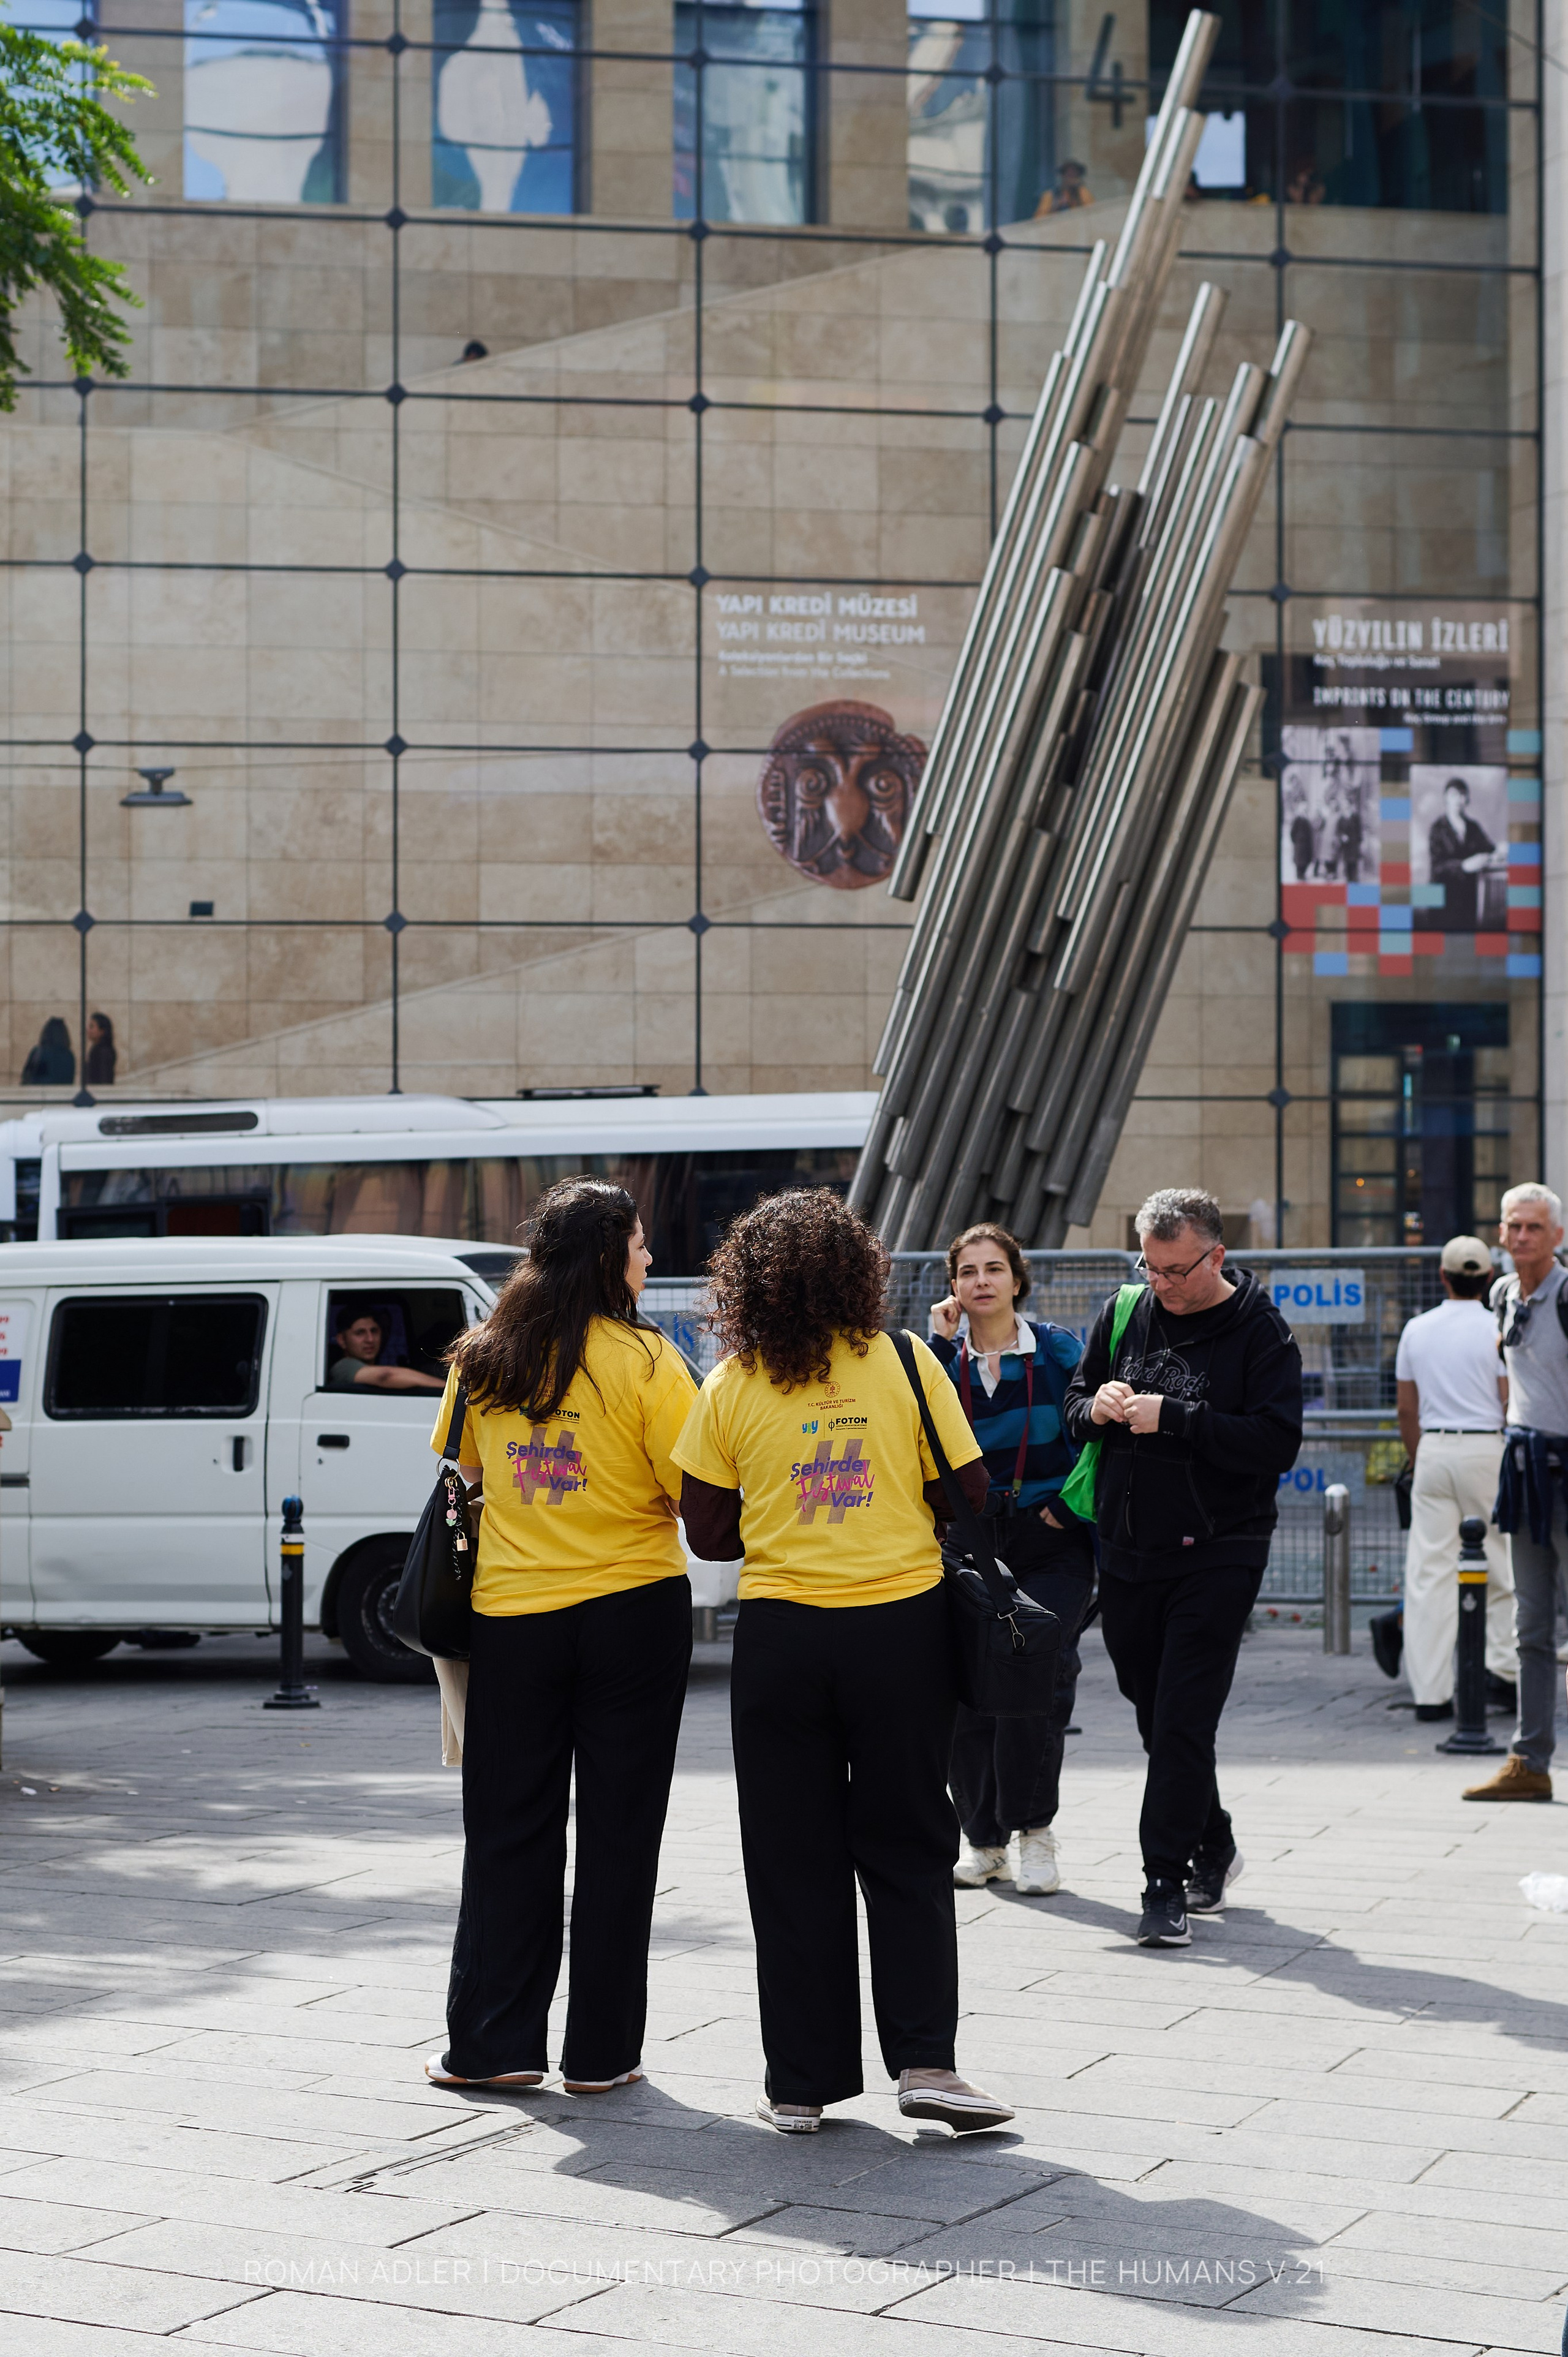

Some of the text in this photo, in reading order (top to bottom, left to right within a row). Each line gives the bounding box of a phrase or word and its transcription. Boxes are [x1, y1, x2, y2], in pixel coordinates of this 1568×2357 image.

[717, 592, 918, 618] YAPI KREDİ MÜZESİ
[717, 619, 925, 644] YAPI KREDİ MUSEUM
[1313, 614, 1508, 653] YÜZYILIN İZLERİ
[1314, 686, 1510, 709] IMPRINTS ON THE CENTURY
[1274, 1278, 1362, 1307] POLİS
[1159, 1366, 1210, 1398] Rock
[555, 1409, 580, 1419] OTON
[506, 1441, 576, 1460] Şehirde
[512, 1452, 587, 1493] Festival
[790, 1455, 864, 1481] Şehirde
[549, 1476, 588, 1492] Var!
[796, 1460, 875, 1512] Festival
[832, 1491, 874, 1507] Var!
